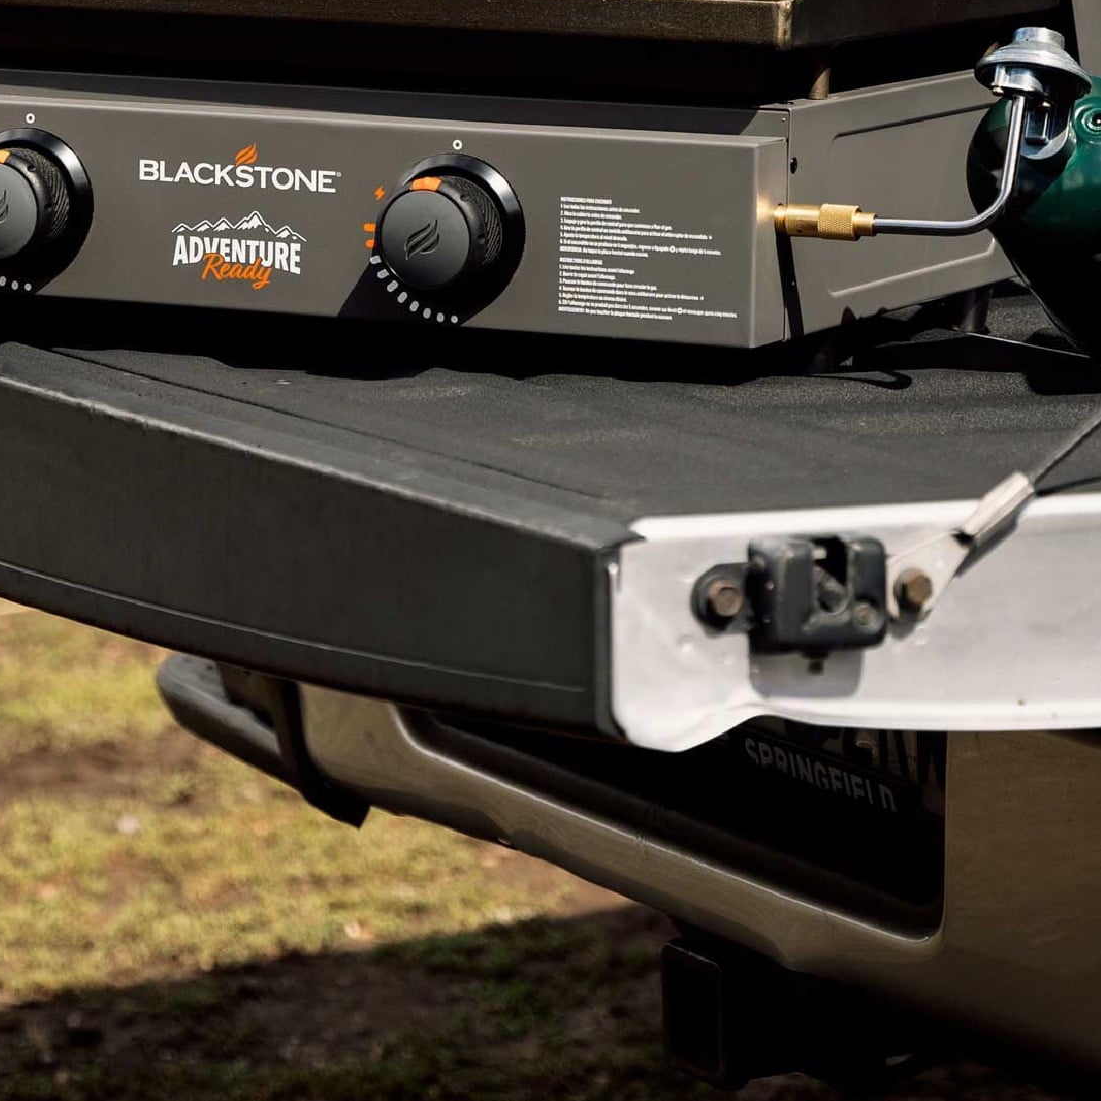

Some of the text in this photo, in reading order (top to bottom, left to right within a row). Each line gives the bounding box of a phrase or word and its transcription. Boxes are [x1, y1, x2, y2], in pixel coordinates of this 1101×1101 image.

[139, 159, 337, 193] BLACKSTONE
[172, 235, 301, 275] ADVENTURE
[201, 253, 273, 290] Ready
